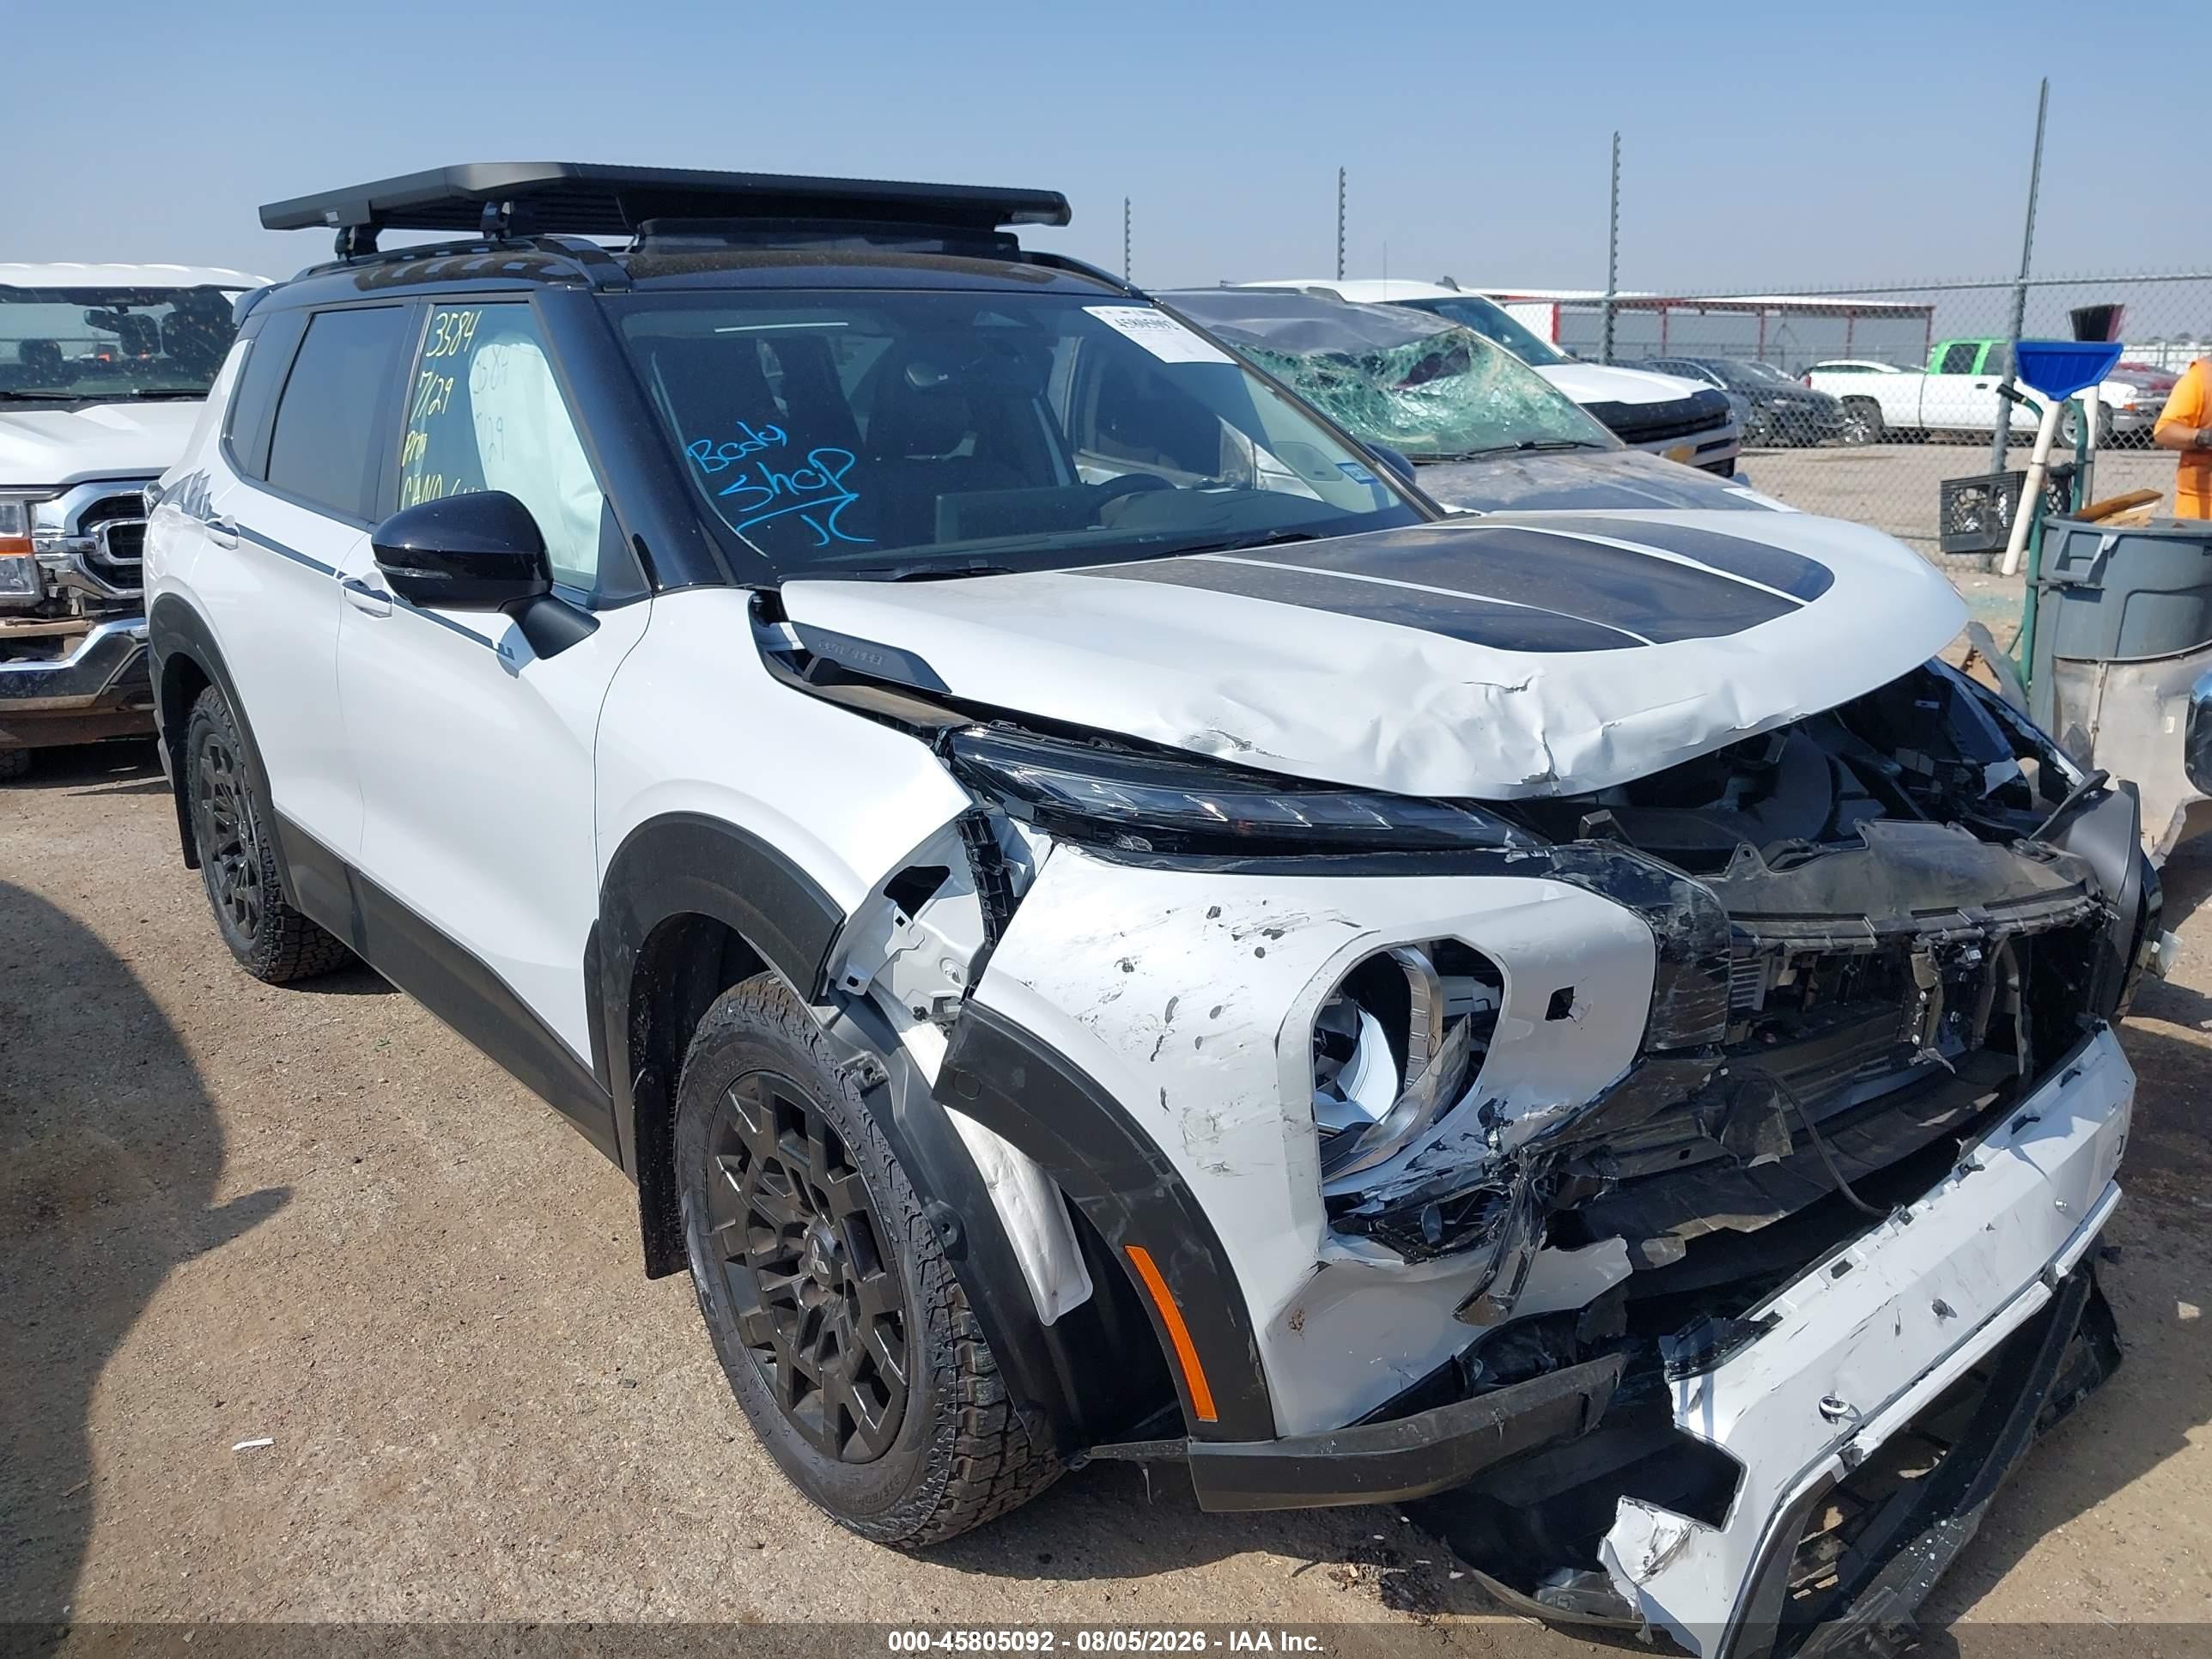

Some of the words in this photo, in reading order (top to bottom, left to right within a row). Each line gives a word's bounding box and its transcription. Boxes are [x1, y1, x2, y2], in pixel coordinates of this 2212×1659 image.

[425, 310, 483, 357] 3584
[410, 370, 454, 424] 7/29
[686, 421, 787, 474] Body
